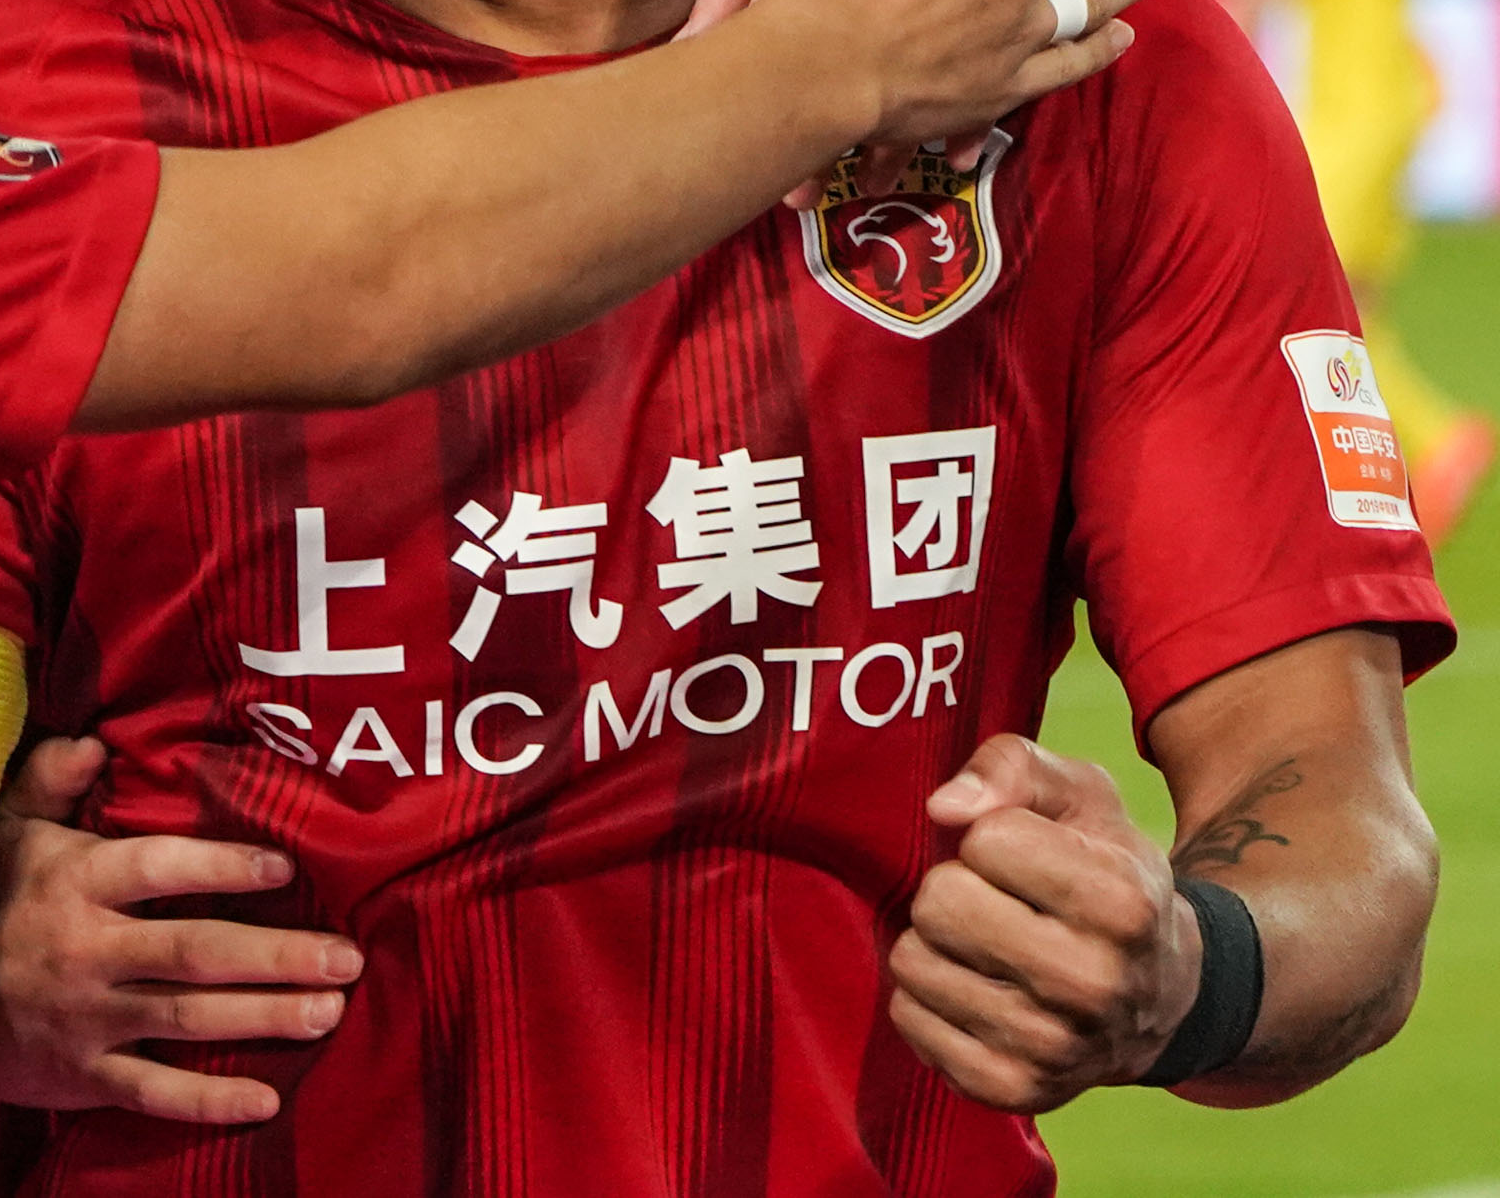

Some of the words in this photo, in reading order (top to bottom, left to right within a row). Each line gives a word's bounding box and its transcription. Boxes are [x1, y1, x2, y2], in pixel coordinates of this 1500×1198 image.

[1331, 425, 1397, 459] 中国平安
[239, 426, 996, 676] 上汽集团
[247, 692, 544, 778] SAIC
[584, 632, 964, 762] MOTOR
